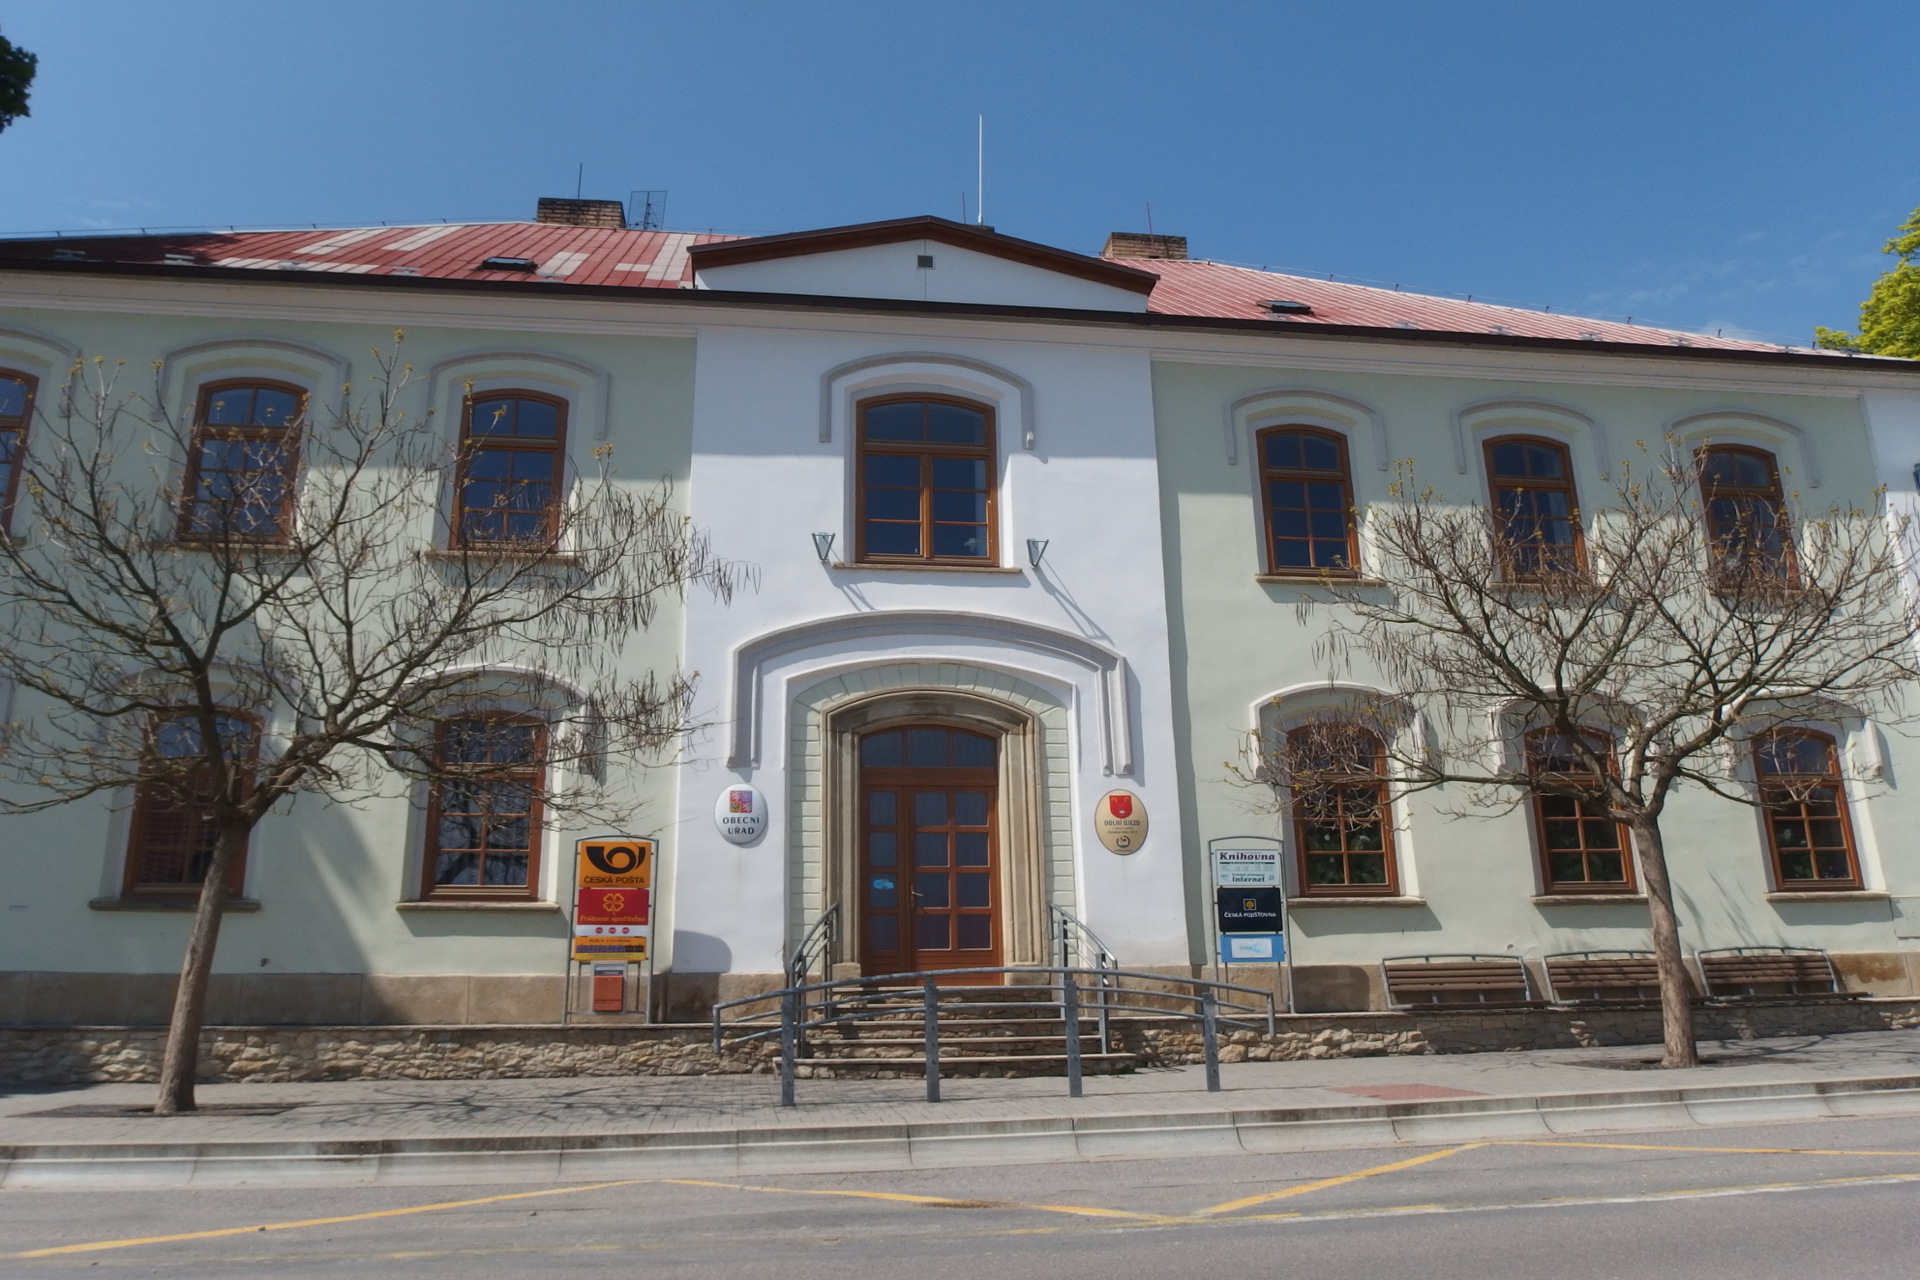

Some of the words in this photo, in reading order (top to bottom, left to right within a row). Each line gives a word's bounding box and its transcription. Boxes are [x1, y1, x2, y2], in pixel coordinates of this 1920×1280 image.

[727, 825, 755, 835] ÚŘAD
[1219, 852, 1275, 860] Knihovna
[583, 875, 613, 884] ČESKÁ
[616, 875, 645, 884] POŠTA
[611, 915, 646, 923] spořitelna
